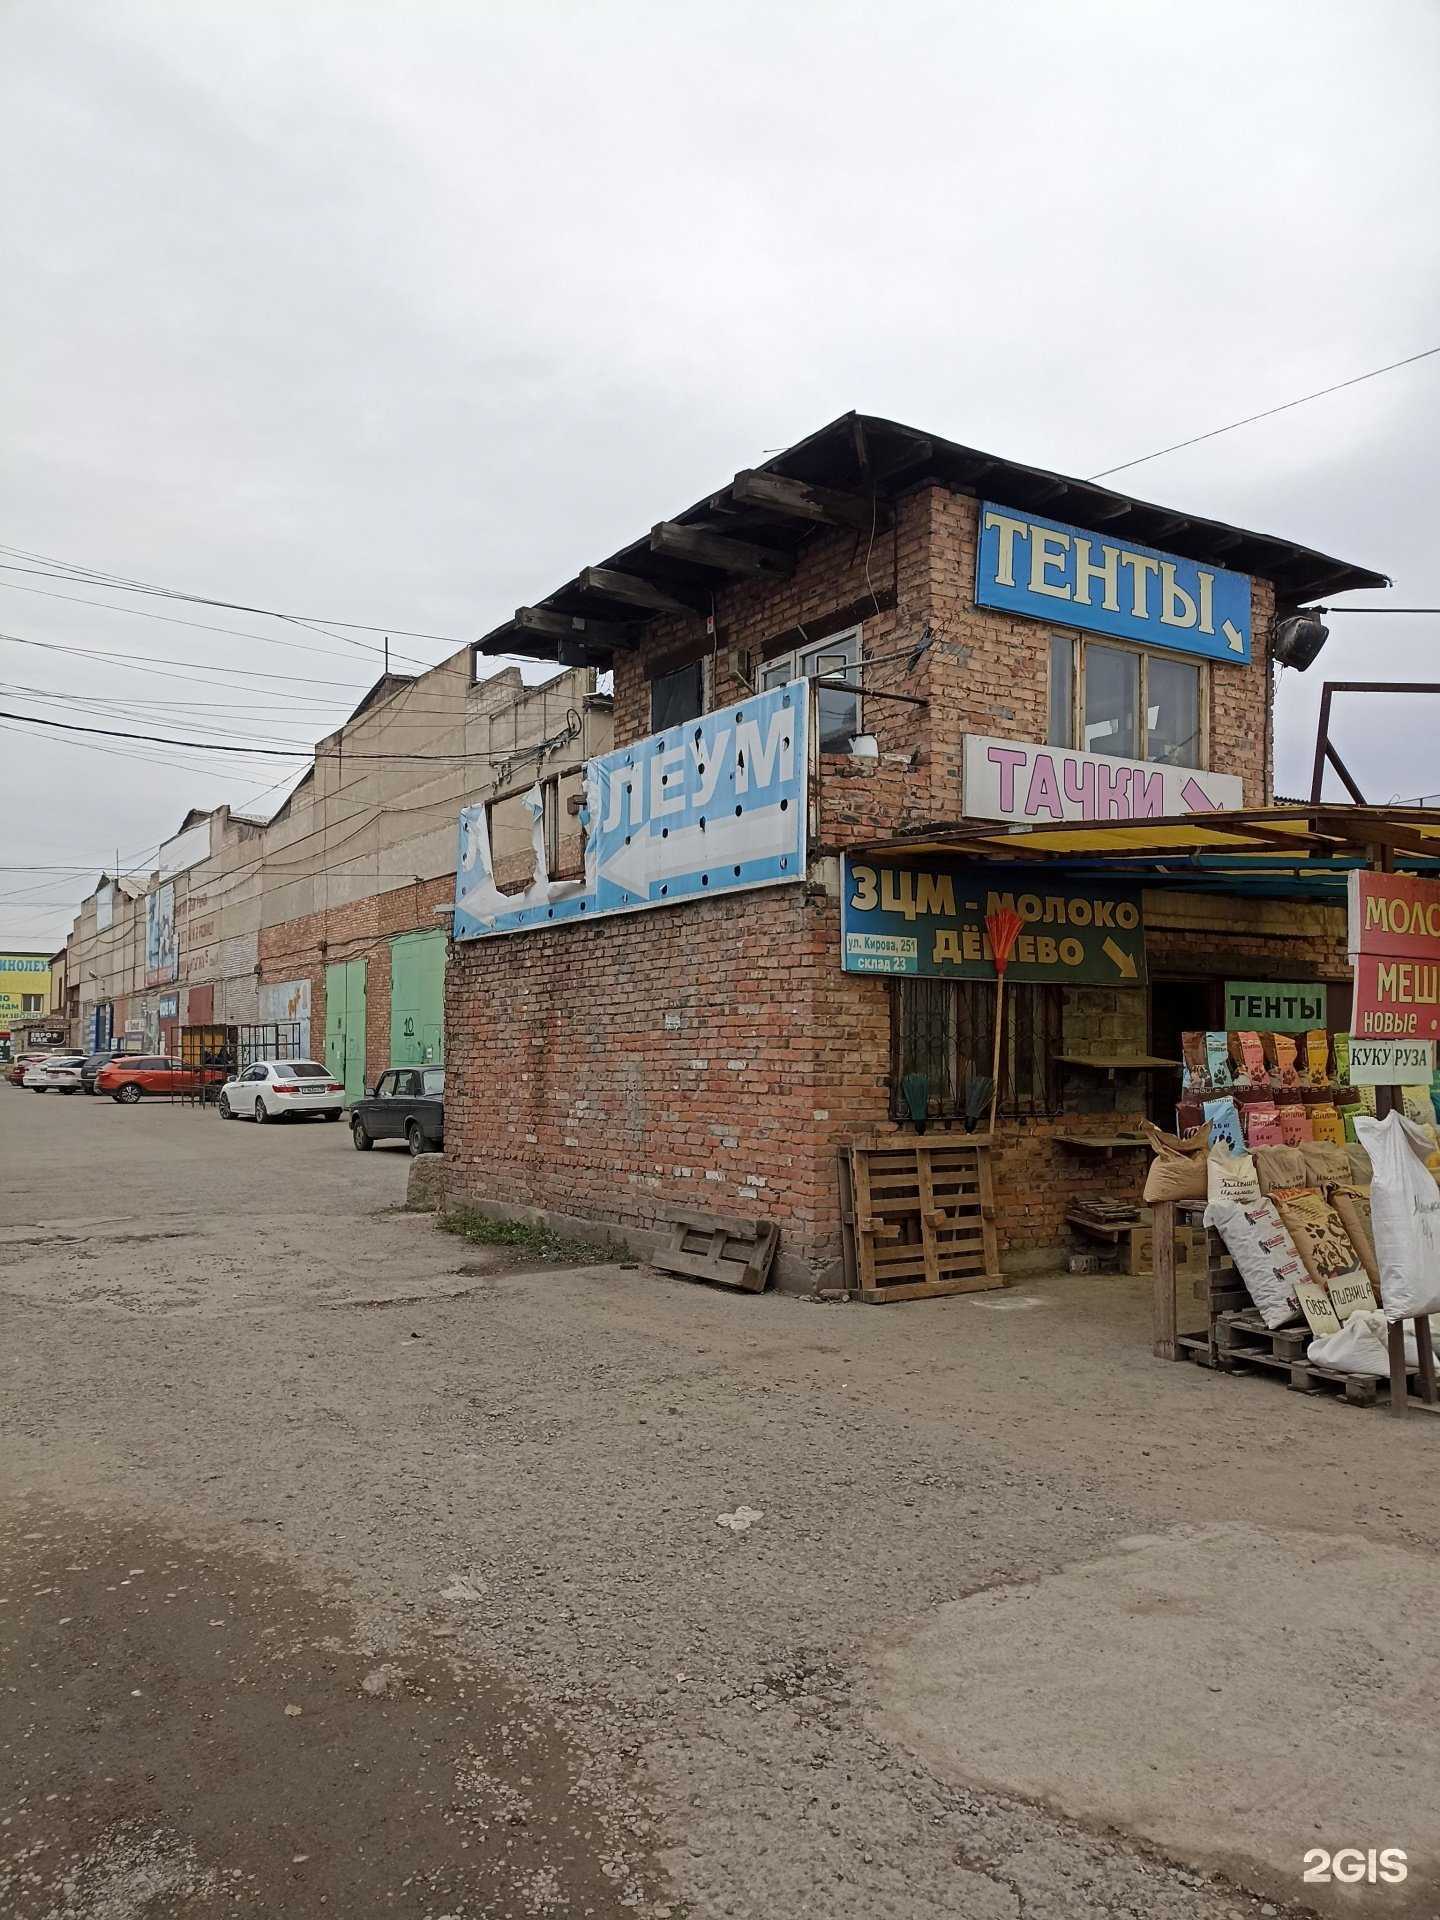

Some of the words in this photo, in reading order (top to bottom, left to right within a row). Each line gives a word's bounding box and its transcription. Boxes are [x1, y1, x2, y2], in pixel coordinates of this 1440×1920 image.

[984, 511, 1215, 636] ТЕНТЫ
[987, 746, 1164, 820] ТАЧКИ
[850, 866, 957, 920] ЗЦМ
[848, 937, 862, 952] ул.
[864, 936, 899, 953] Кирова,
[857, 957, 891, 972] склад
[893, 956, 907, 971] 23
[1377, 961, 1440, 1005] МЕШ
[1230, 995, 1323, 1020] ТЕНТЫ
[404, 1016, 414, 1033] 10
[1332, 1282, 1373, 1305] ПШЕНИЦА
